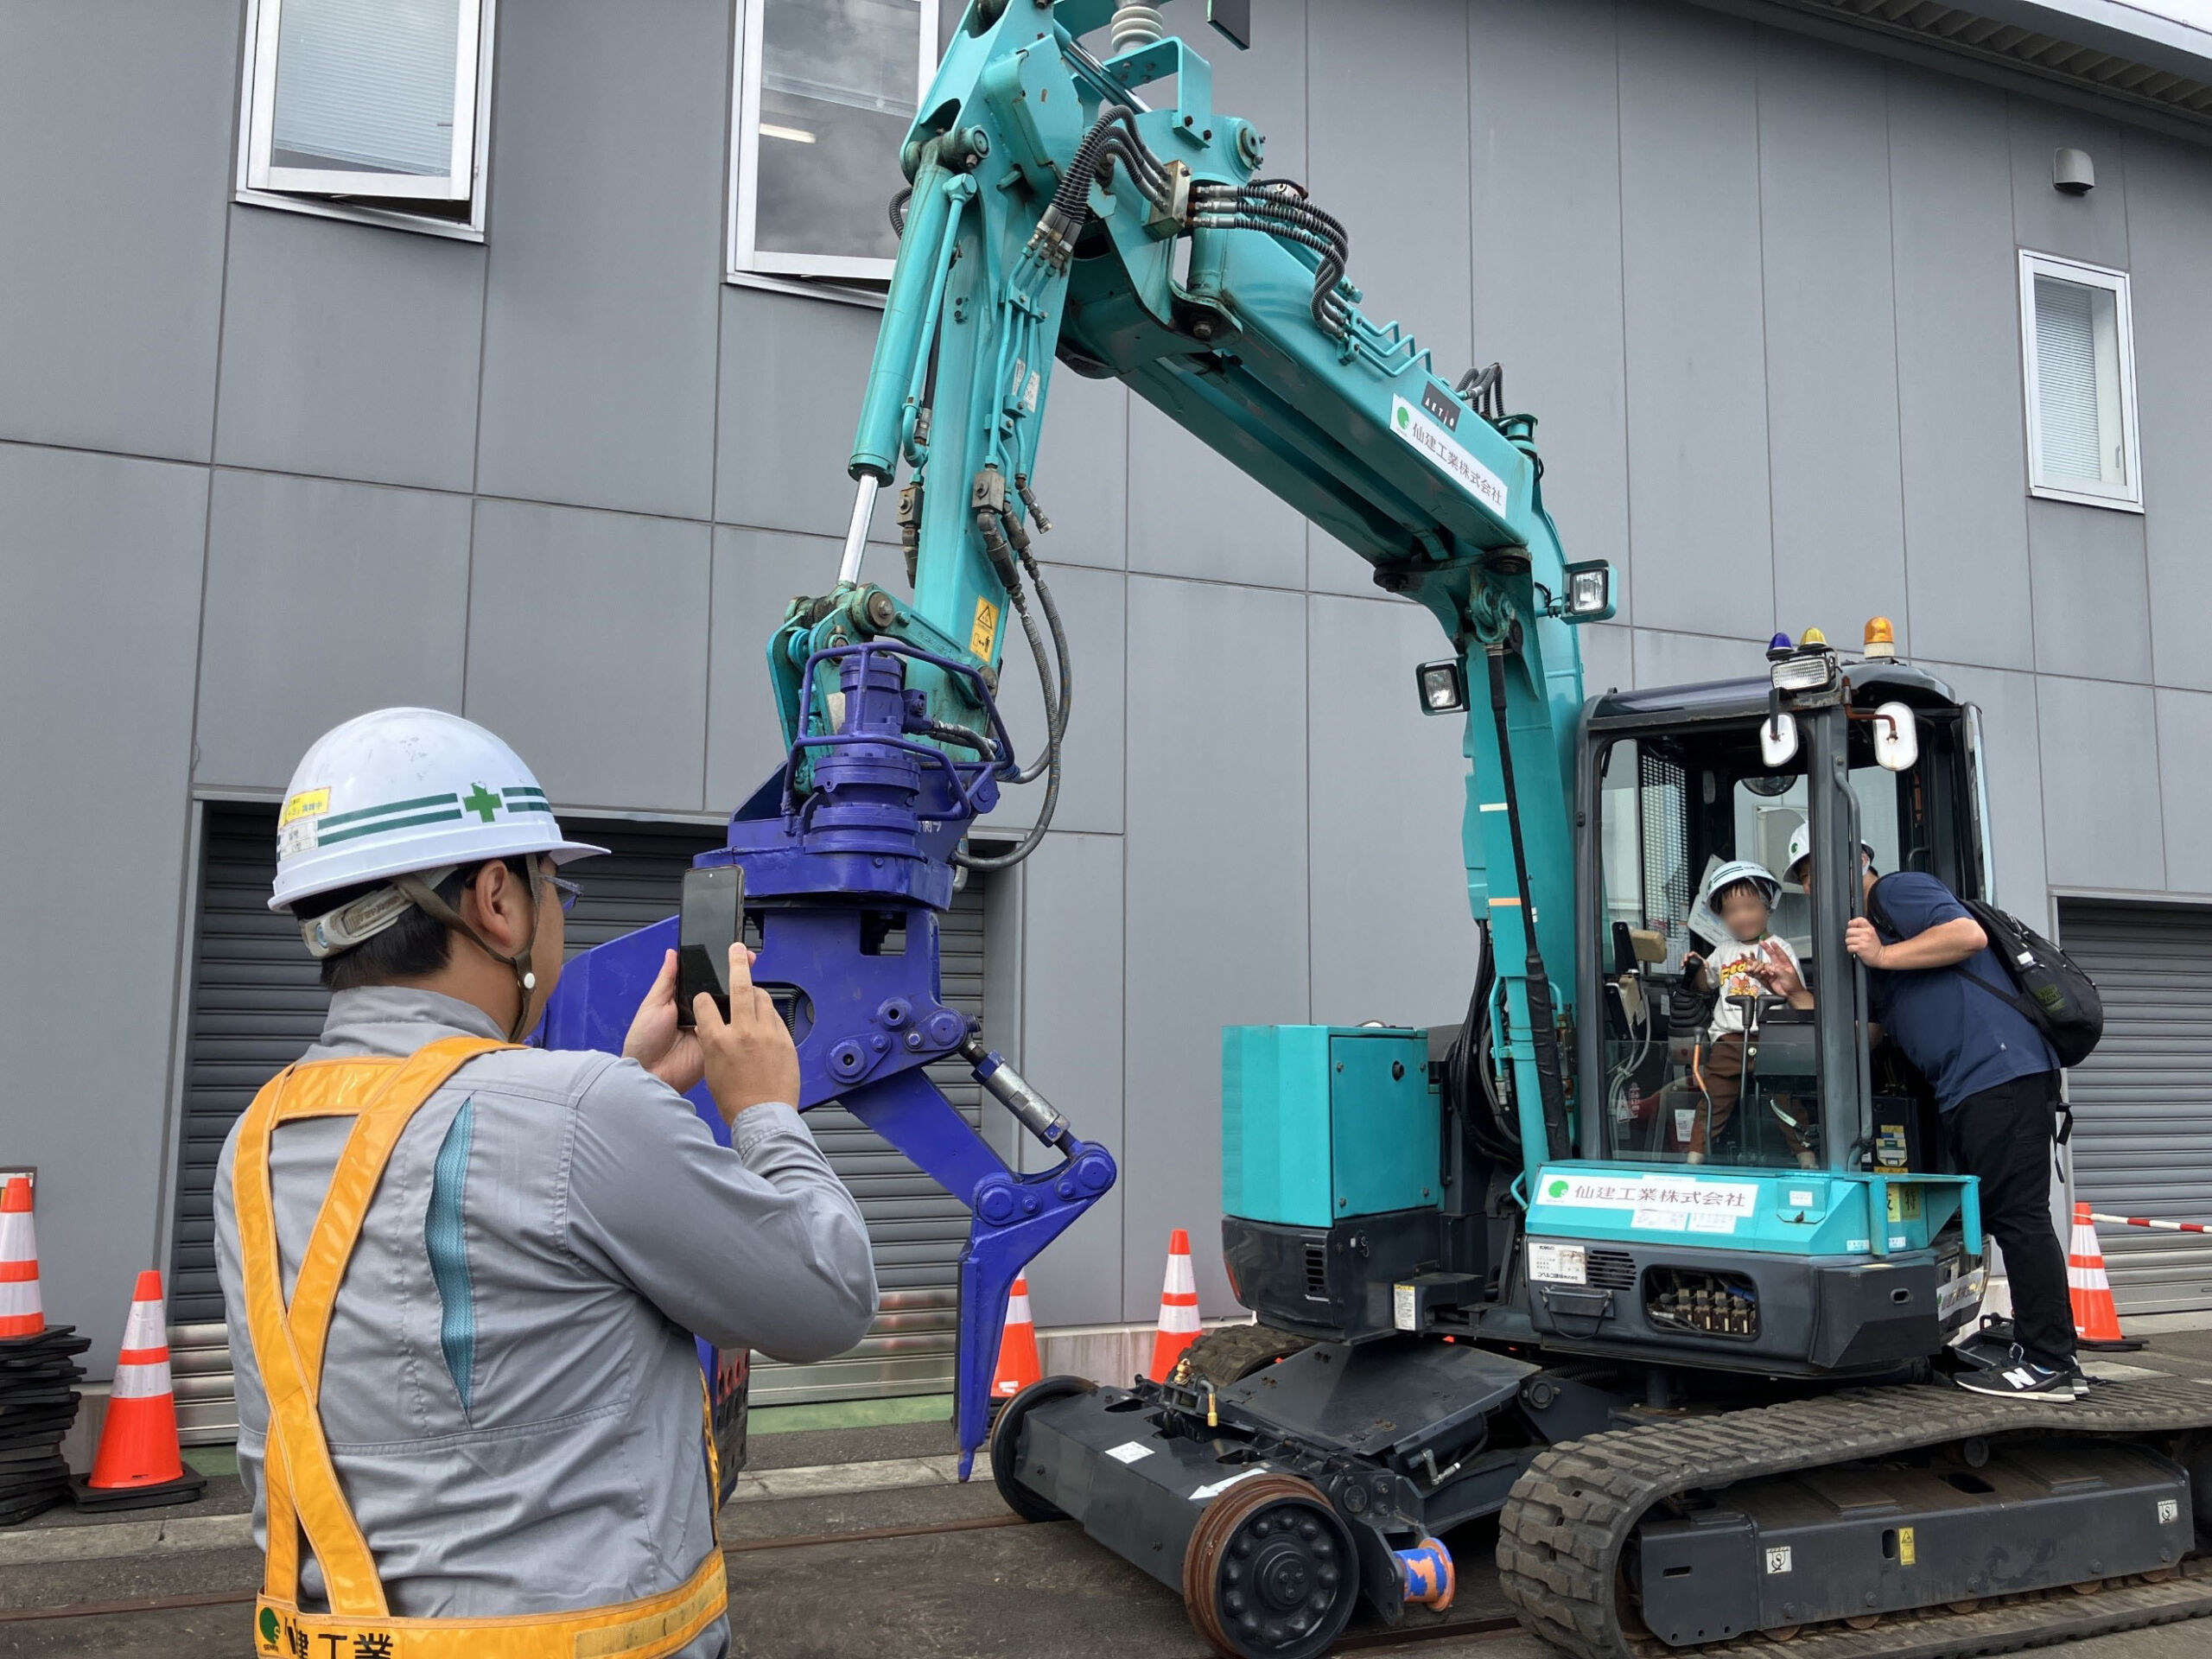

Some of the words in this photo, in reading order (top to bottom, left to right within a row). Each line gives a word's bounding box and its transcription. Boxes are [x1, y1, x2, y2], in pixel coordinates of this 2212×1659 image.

[1412, 421, 1502, 505] 仙建工業株式会社
[1574, 1185, 1746, 1208] 仙建工業株式会社
